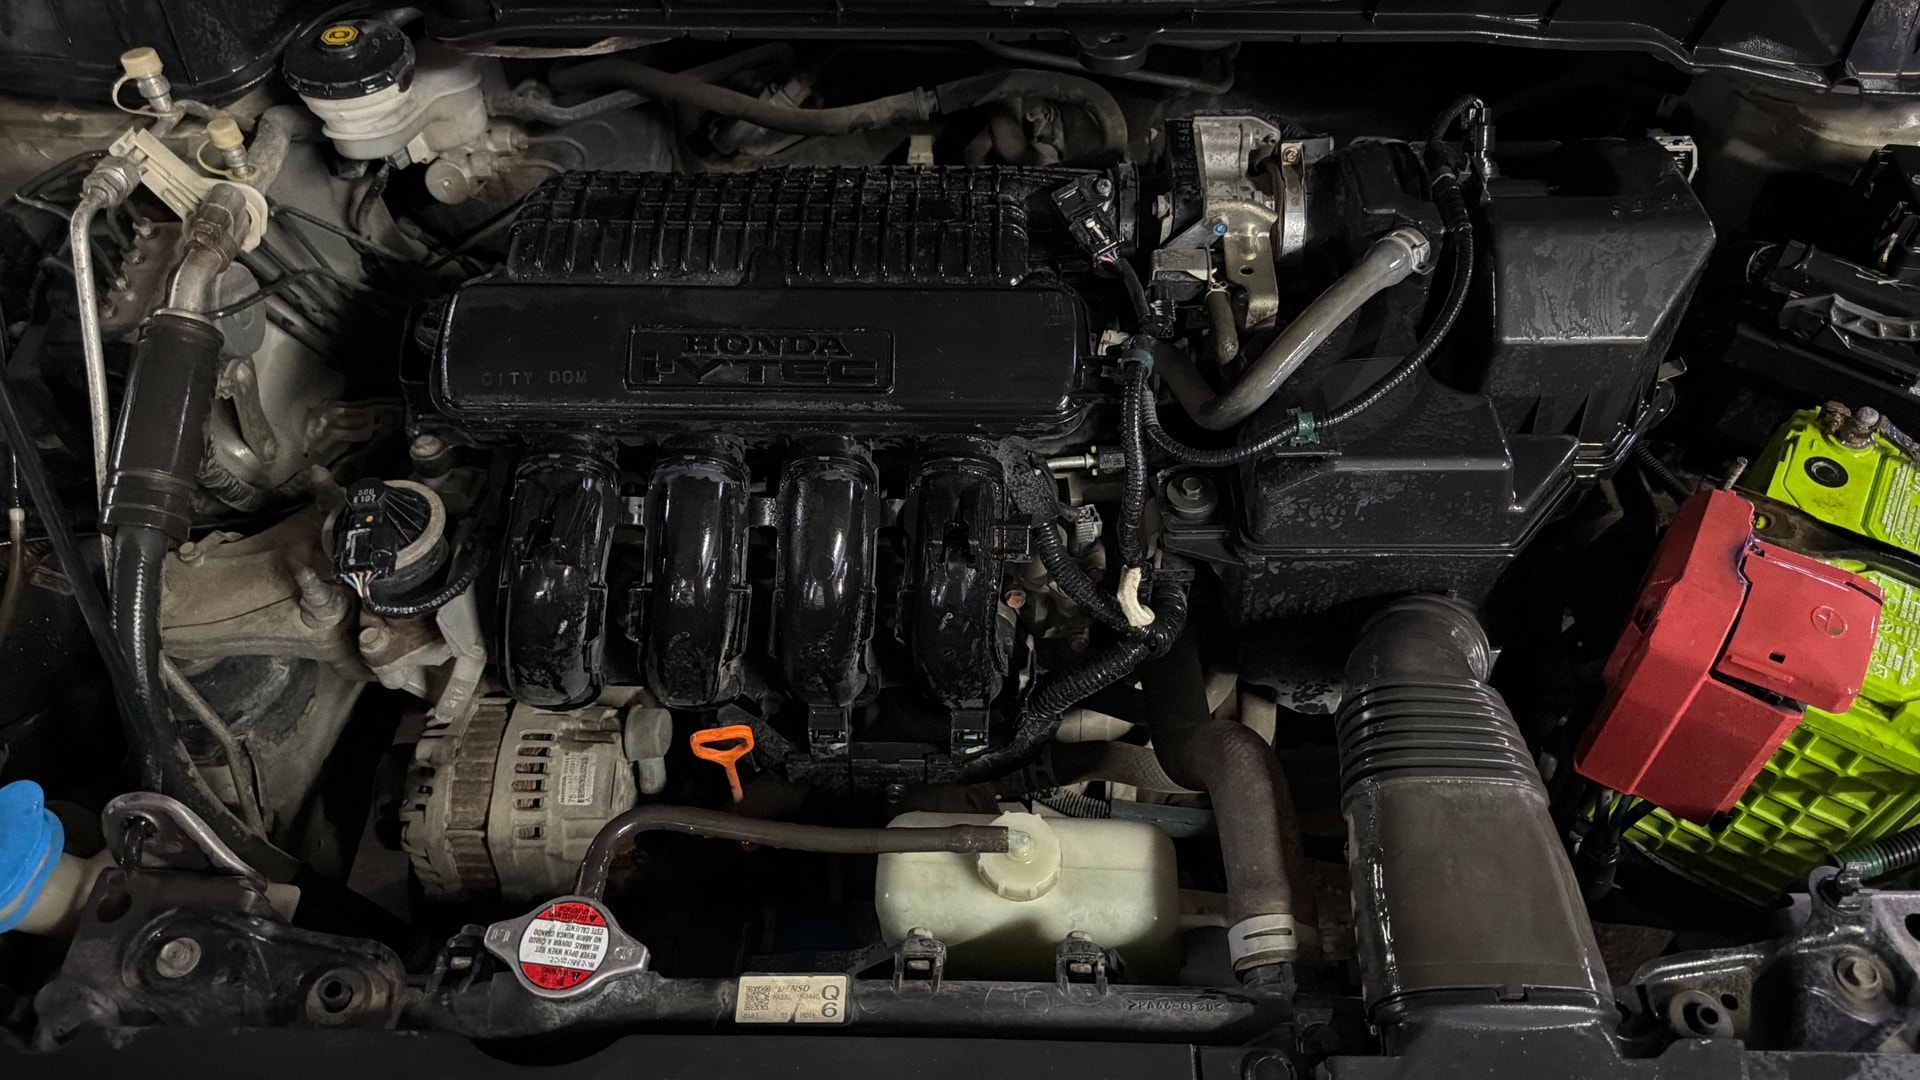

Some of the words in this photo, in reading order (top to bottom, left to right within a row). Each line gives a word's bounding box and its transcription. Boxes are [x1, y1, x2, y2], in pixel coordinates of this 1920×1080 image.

[682, 335, 852, 358] HONDA
[480, 370, 534, 386] CITY
[556, 931, 574, 939] NUNCA
[576, 934, 592, 942] ABRIR
[547, 948, 563, 956] WHEN
[564, 949, 579, 958] OPEN
[580, 952, 597, 960] NEVER
[778, 984, 811, 993] DENSO
[821, 984, 840, 1001] Q
[821, 1002, 838, 1018] 6
